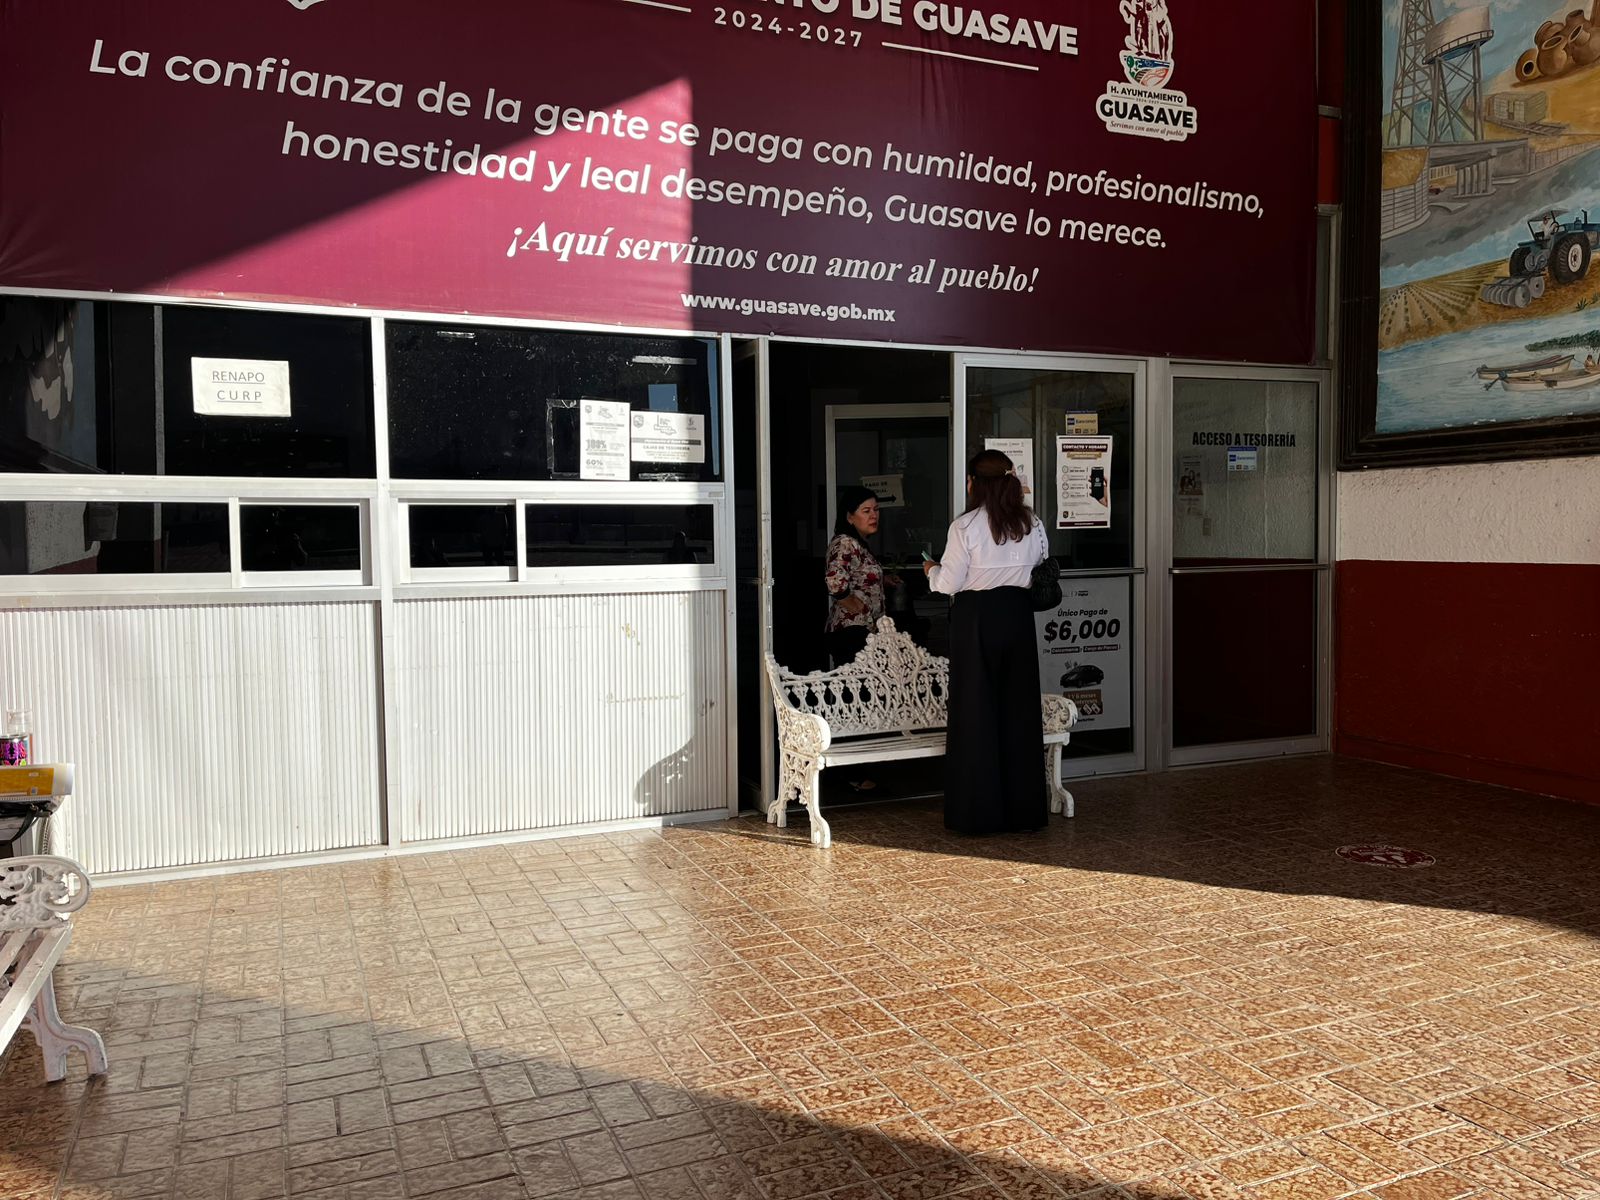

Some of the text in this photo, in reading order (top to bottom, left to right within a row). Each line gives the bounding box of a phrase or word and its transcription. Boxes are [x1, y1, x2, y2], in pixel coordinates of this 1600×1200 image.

[714, 7, 862, 47] 2024-2027
[852, 0, 1078, 55] DE GUASAVE
[1110, 85, 1183, 103] H. AYUNTAMIENTO
[89, 39, 1264, 218] La confianza de la gente se paga con humildad, profesionalismo,
[1100, 98, 1194, 129] GUASAVE
[281, 121, 1166, 248] honestidad y leal desempeño, Guasave lo merece.
[506, 221, 1039, 293] ¡Aquí servimos con amor al pueblo!
[680, 292, 896, 322] www.guasave.gob.mx
[212, 370, 265, 383] RENAPO
[1192, 431, 1296, 447] ACCESO A TESORERÍA
[585, 458, 604, 466] 60%
[1057, 607, 1108, 618] Único Pago de
[1043, 618, 1121, 644] $6,000
